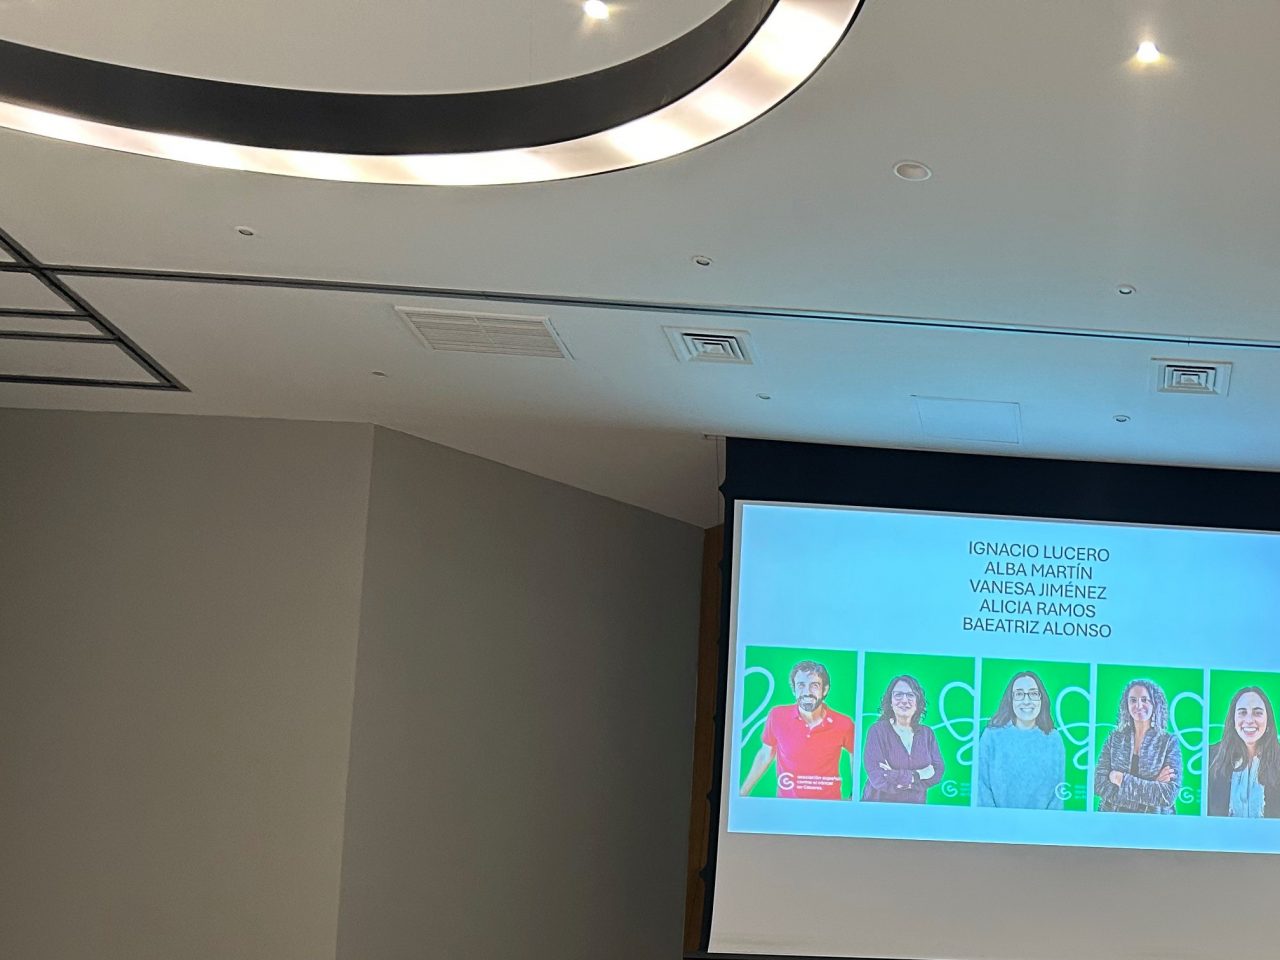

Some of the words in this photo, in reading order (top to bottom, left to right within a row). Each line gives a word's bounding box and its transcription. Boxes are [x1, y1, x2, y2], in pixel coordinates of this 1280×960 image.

[969, 541, 1039, 558] IGNACIO
[1043, 545, 1110, 562] LUCERO
[984, 561, 1027, 577] ALBA
[1031, 563, 1093, 580] MARTÍN
[969, 578, 1036, 596] VANESA
[1038, 581, 1107, 600] JIMÉNEZ
[979, 598, 1033, 615] ALICIA
[1037, 602, 1096, 618] RAMOS
[963, 617, 1040, 635] BAEATRIZ
[1043, 621, 1112, 638] ALONSO
